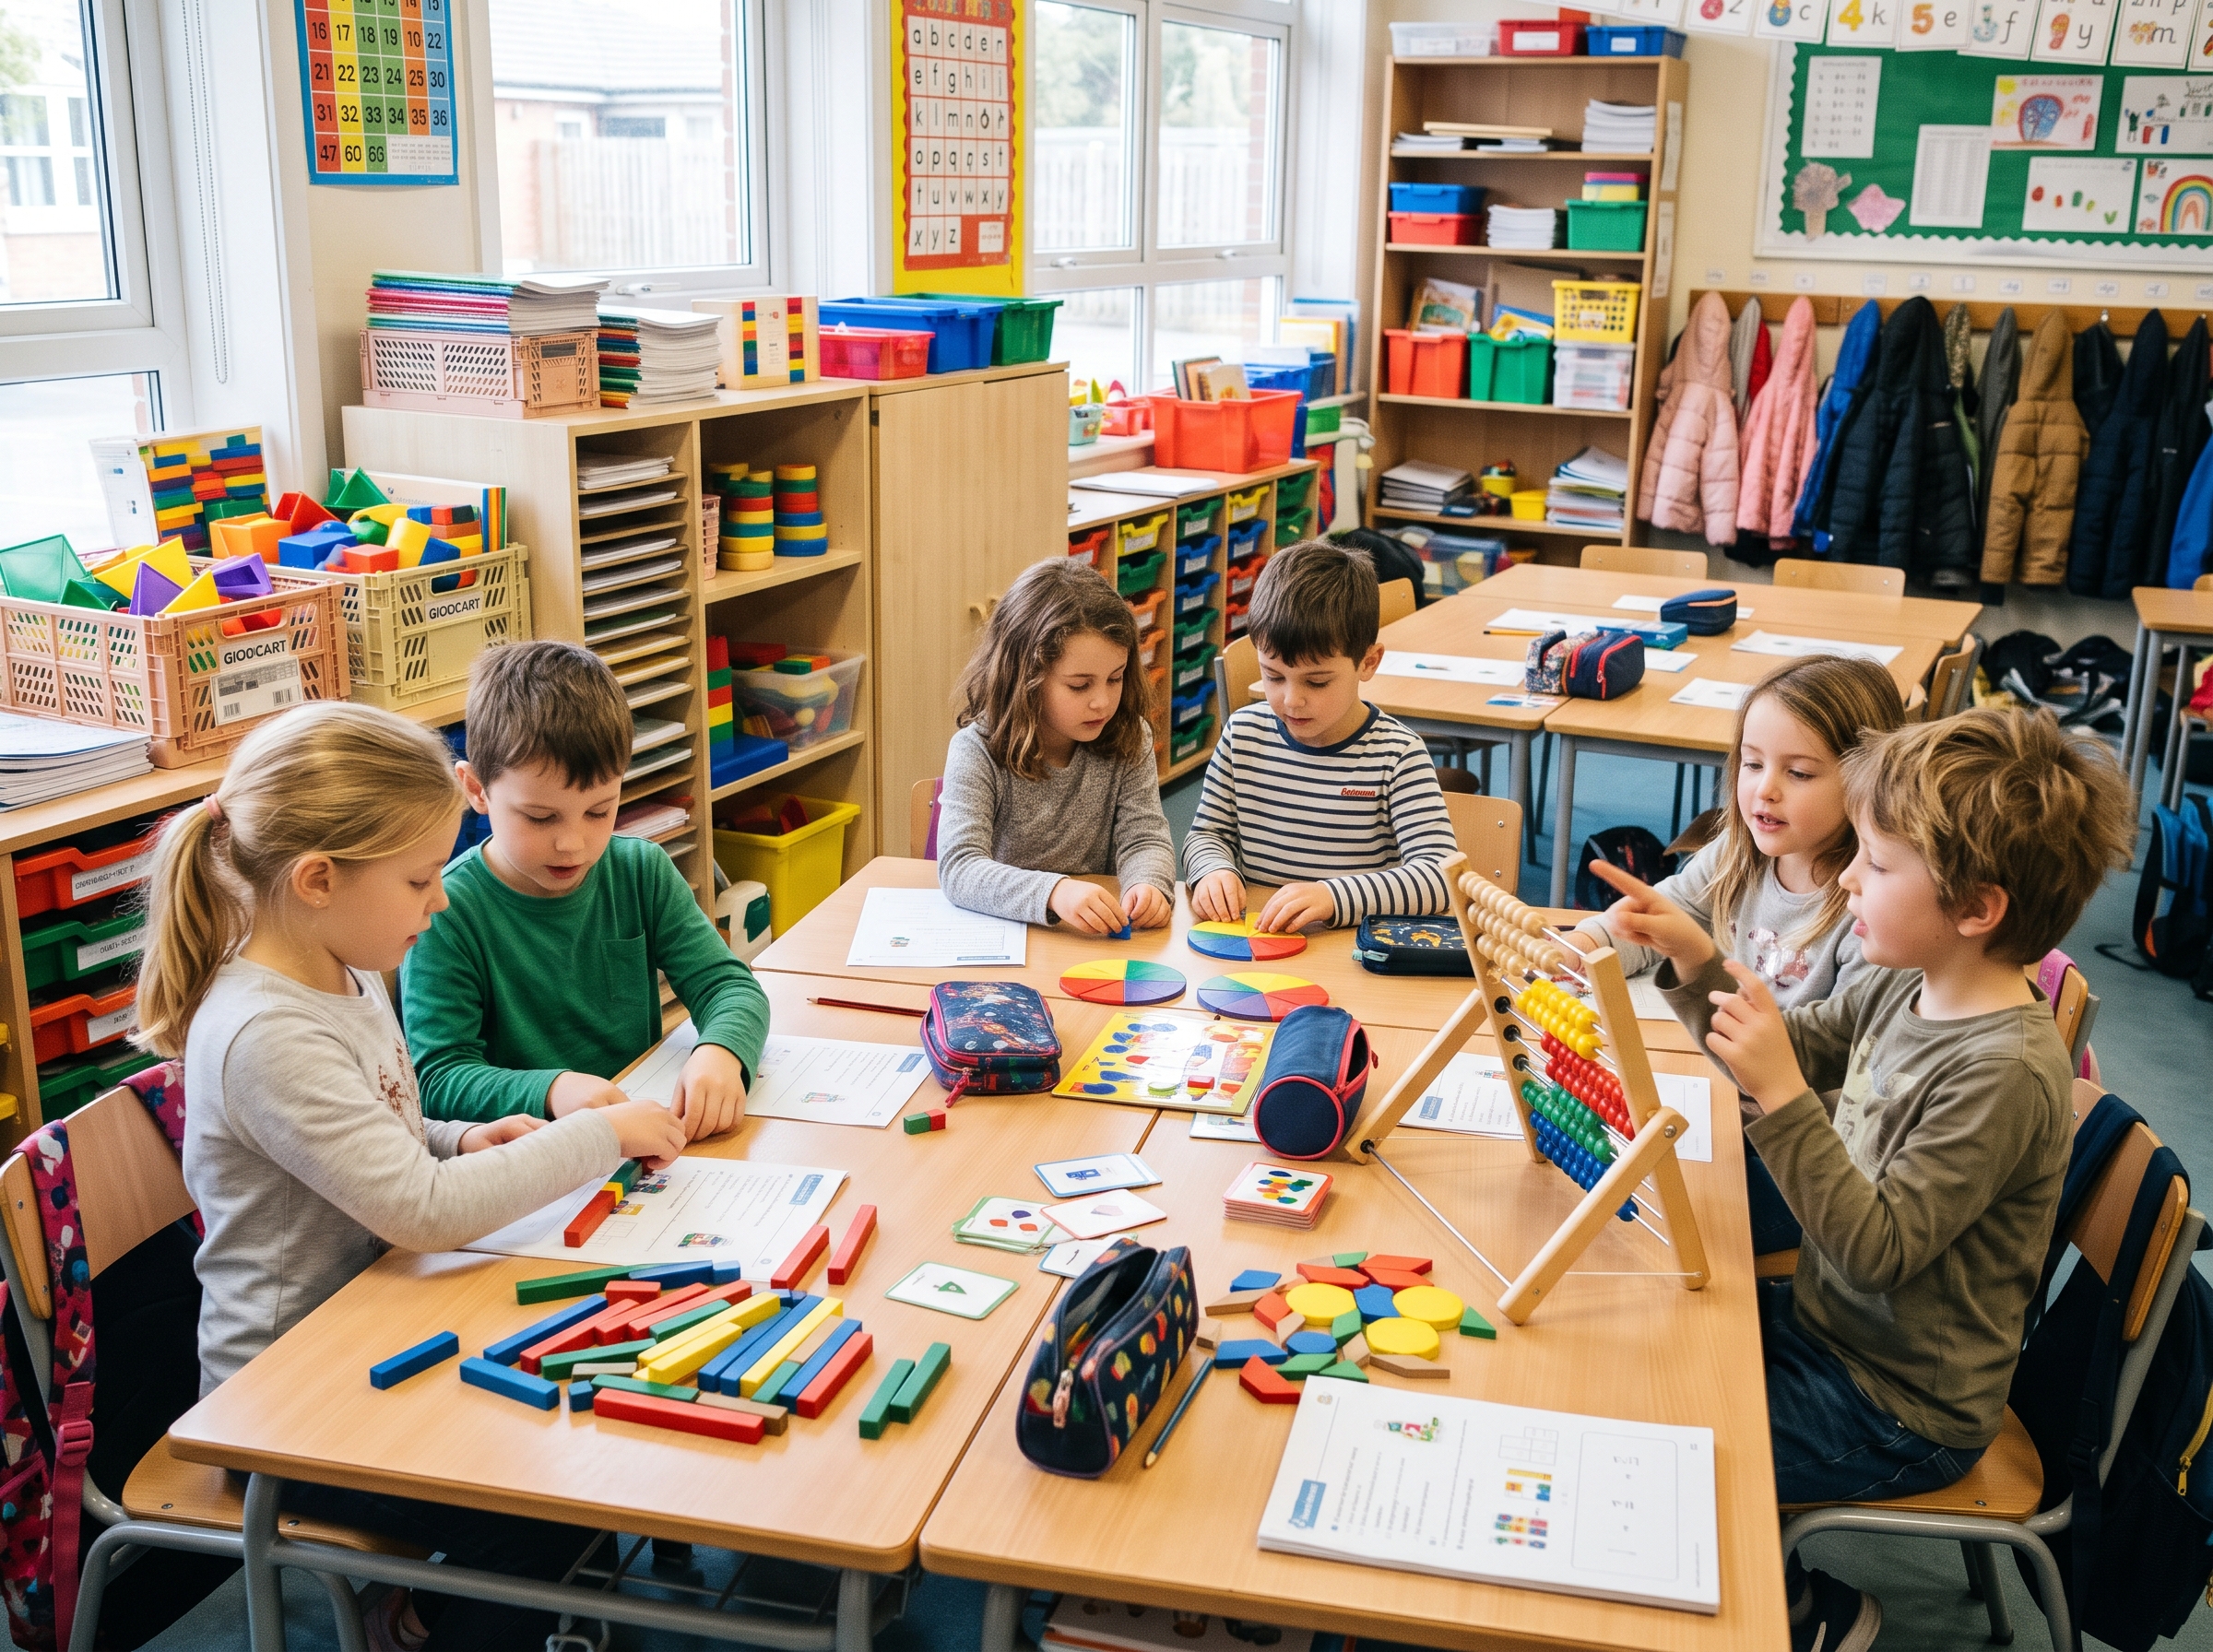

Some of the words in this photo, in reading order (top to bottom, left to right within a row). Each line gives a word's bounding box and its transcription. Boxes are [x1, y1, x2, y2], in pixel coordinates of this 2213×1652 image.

[1799, 5, 1811, 20] c
[1838, 0, 1864, 31] 4
[1872, 1, 1887, 25] k
[1911, 4, 1934, 34] 5
[1944, 10, 1957, 28] e
[312, 22, 327, 40] 16
[336, 24, 350, 41] 17
[361, 27, 375, 43] 18
[384, 29, 397, 45] 19
[408, 31, 421, 47] 10
[427, 32, 442, 49] 22
[913, 29, 921, 44] a
[930, 24, 939, 46] b
[948, 32, 955, 48] c
[964, 29, 972, 50] d
[980, 36, 988, 52] e
[1999, 10, 2019, 44] f
[2077, 24, 2093, 49] y
[2150, 26, 2176, 44] m
[314, 63, 329, 80] 21
[337, 65, 356, 82] 22
[362, 66, 379, 83] 23
[385, 68, 402, 85] 24
[408, 70, 424, 86] 25
[430, 71, 444, 88] 30
[914, 68, 922, 85] e
[948, 72, 956, 93] g
[964, 66, 972, 88] h
[316, 103, 333, 122] 31
[341, 105, 359, 123] 32
[365, 106, 382, 124] 33
[388, 107, 404, 124] 34
[411, 109, 427, 125] 35
[432, 110, 447, 125] 36
[915, 102, 923, 126] k
[948, 112, 959, 127] m
[965, 113, 973, 127] n
[320, 145, 337, 161] 47
[345, 145, 361, 161] 60
[916, 149, 923, 165] o
[932, 150, 941, 172] p
[949, 150, 957, 172] q
[982, 152, 988, 166] s
[932, 189, 940, 205] u
[950, 190, 957, 205] v
[964, 190, 975, 205] w
[981, 190, 988, 205] x
[997, 190, 1004, 210] y
[914, 230, 922, 247] x
[931, 230, 940, 250] y
[949, 229, 956, 243] z
